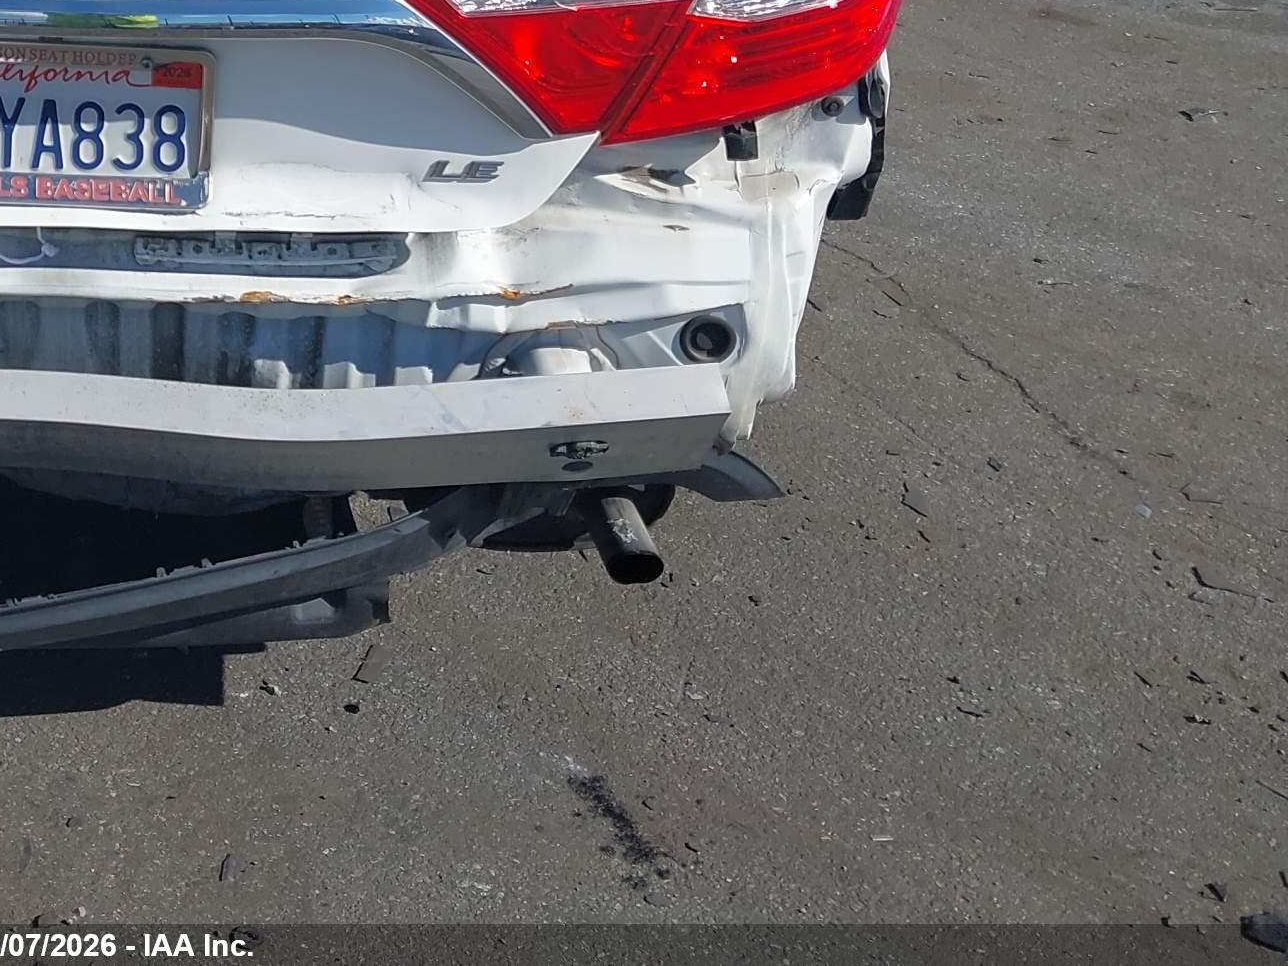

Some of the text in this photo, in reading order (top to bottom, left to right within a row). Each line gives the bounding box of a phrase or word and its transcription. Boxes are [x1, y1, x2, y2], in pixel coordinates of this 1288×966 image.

[30, 48, 68, 62] SEAT
[422, 160, 504, 183] LE
[35, 177, 182, 205] BASEBALL
